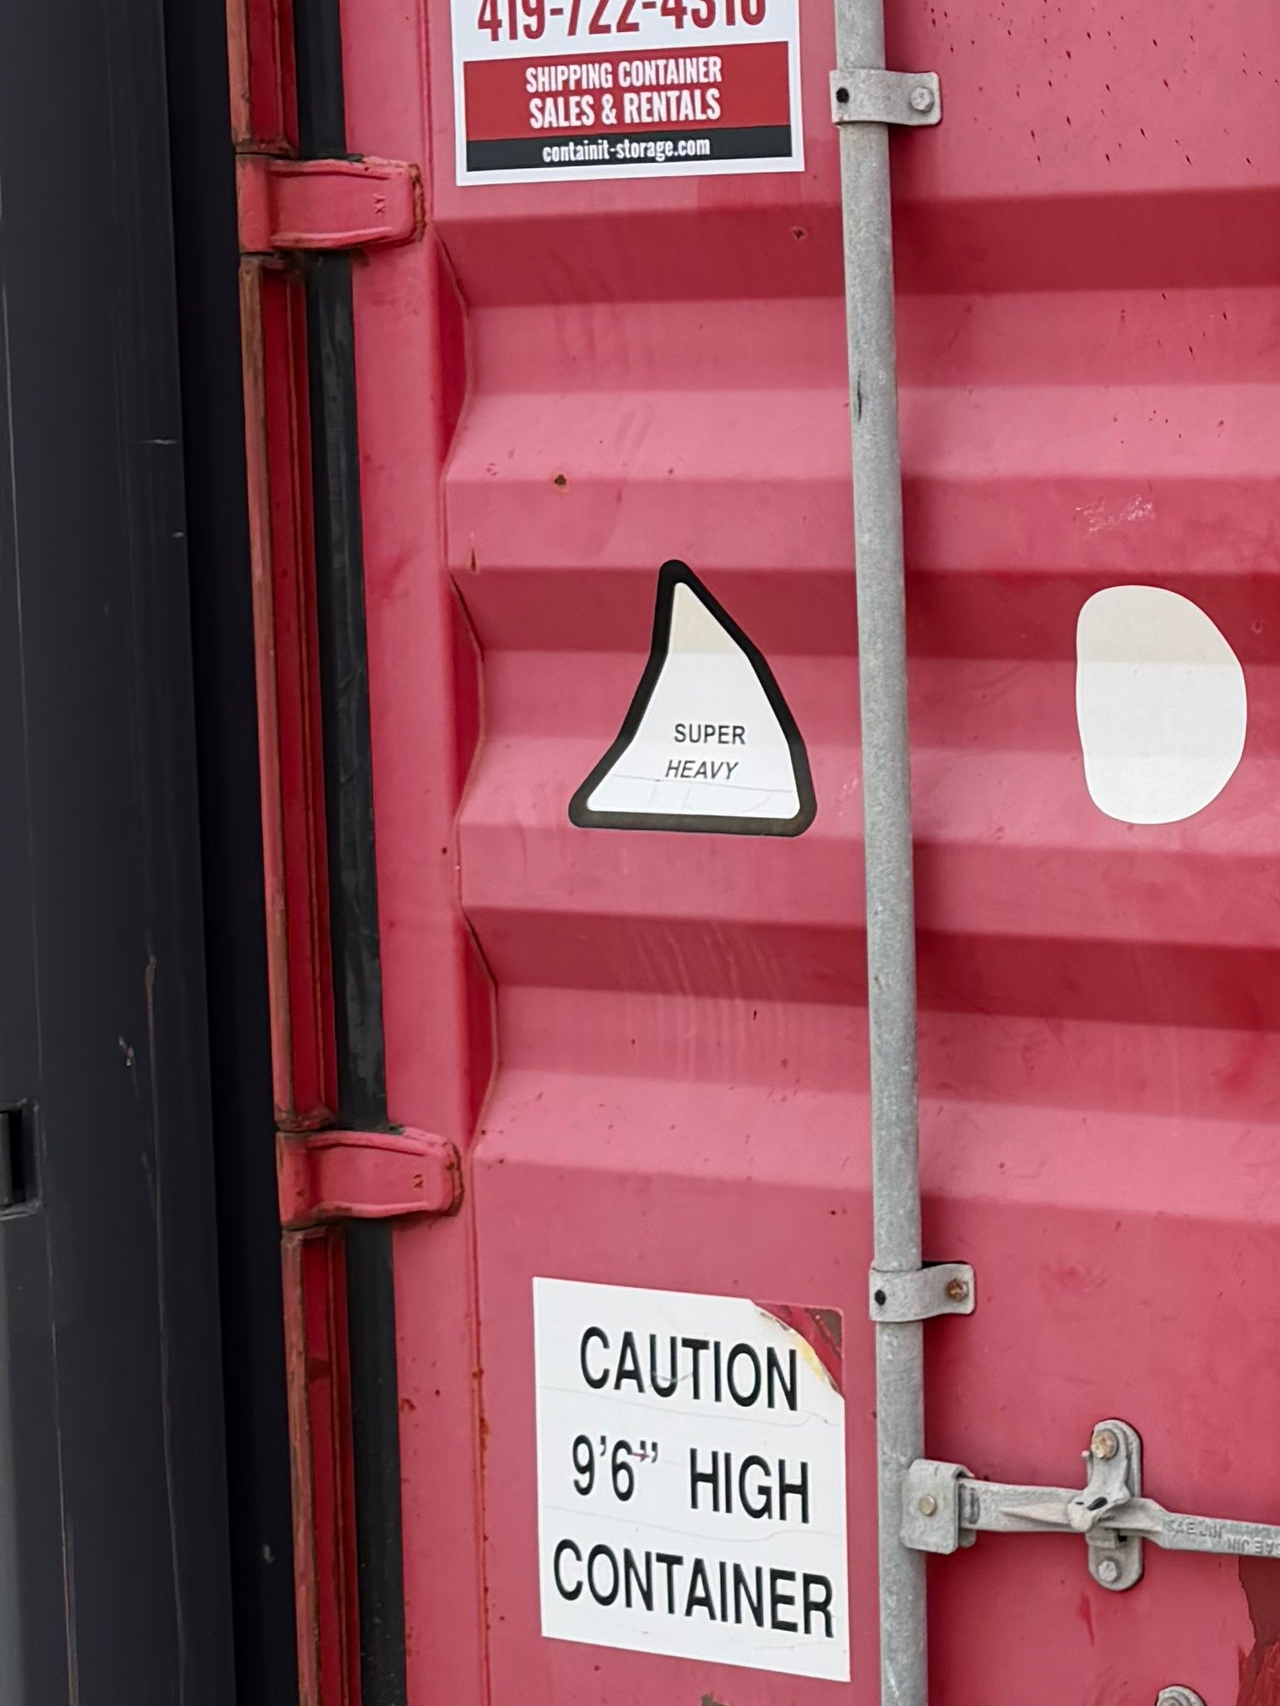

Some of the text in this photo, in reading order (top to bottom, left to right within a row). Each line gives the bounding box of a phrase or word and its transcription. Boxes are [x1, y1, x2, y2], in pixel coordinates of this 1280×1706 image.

[525, 56, 722, 93] SHIPPING CONTAINER
[529, 89, 721, 128] SALES & RENTALS
[542, 134, 711, 165] containit-storage.com
[674, 723, 745, 745] SUPER
[665, 759, 739, 780] HEAVY
[580, 1326, 798, 1411] CAUTION
[690, 1448, 809, 1524] HIGH
[554, 1539, 834, 1638] CONTAINER
